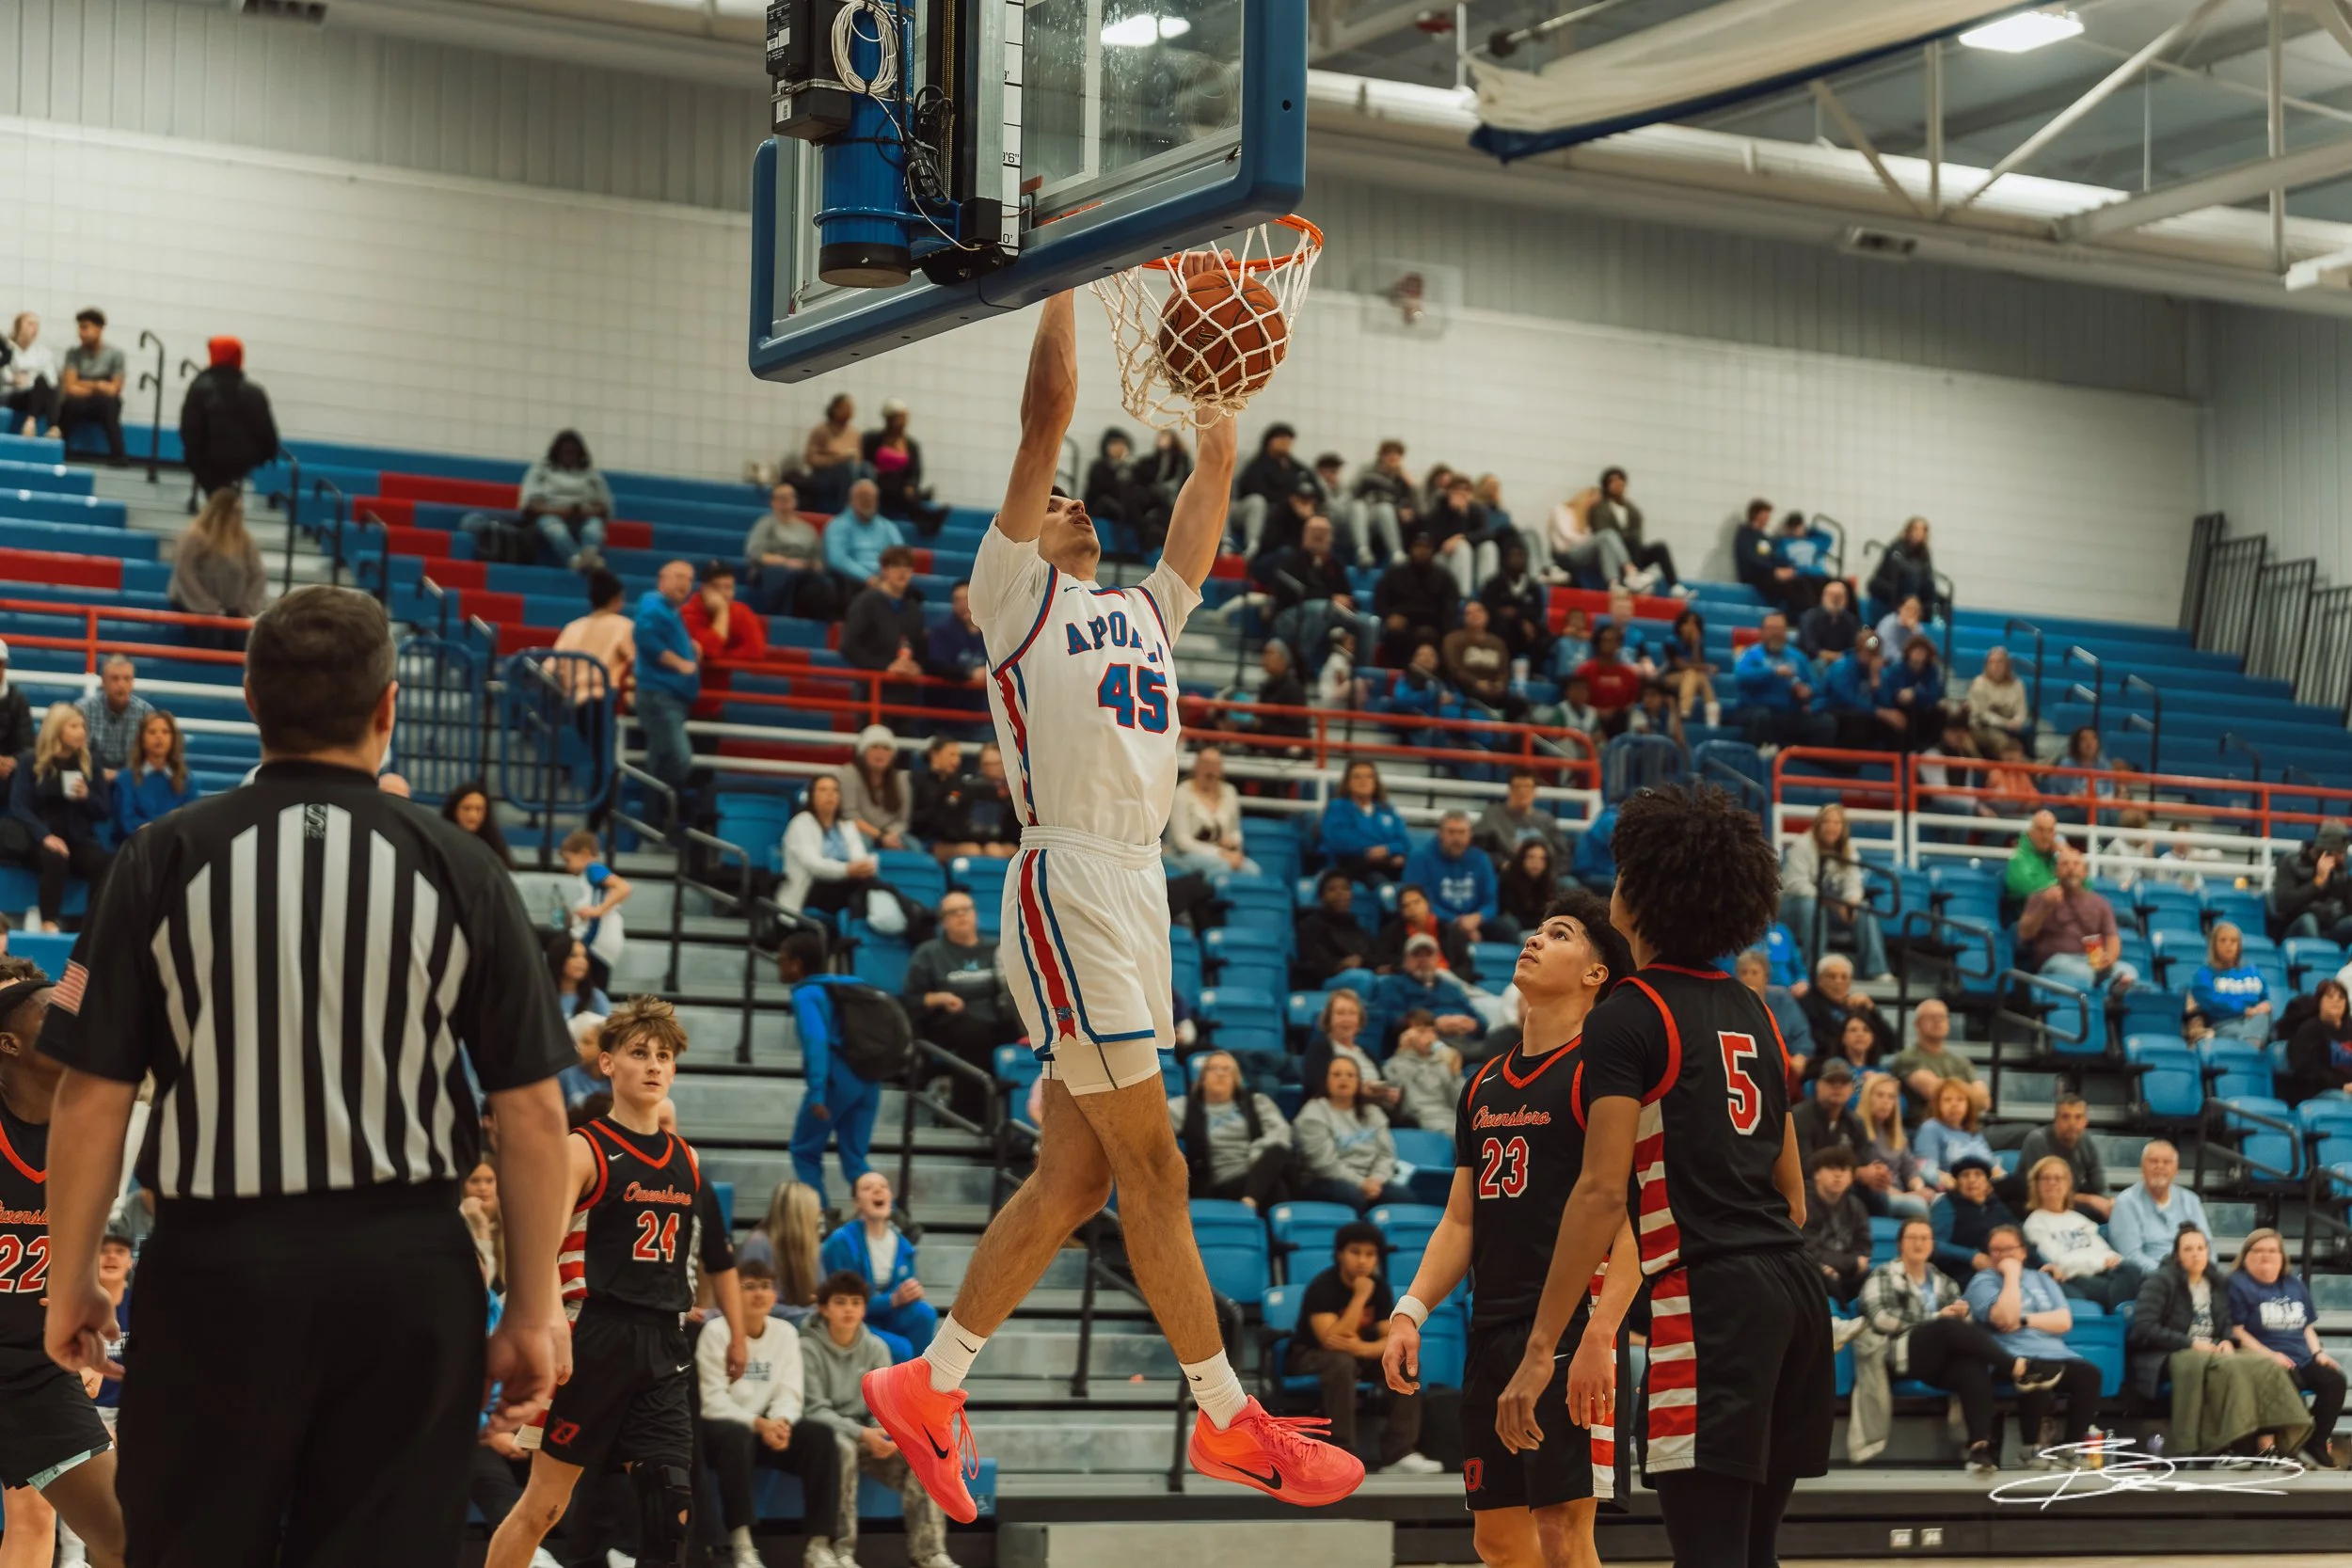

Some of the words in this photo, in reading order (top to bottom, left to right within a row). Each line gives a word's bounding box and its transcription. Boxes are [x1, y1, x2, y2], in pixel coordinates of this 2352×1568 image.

[1097, 662, 1169, 735] 45
[1717, 1029, 1762, 1136] 5
[1472, 1104, 1551, 1132] Owensboro
[1478, 1136, 1530, 1199] 23
[0, 1234, 51, 1293] 22
[632, 1210, 680, 1262] 24
